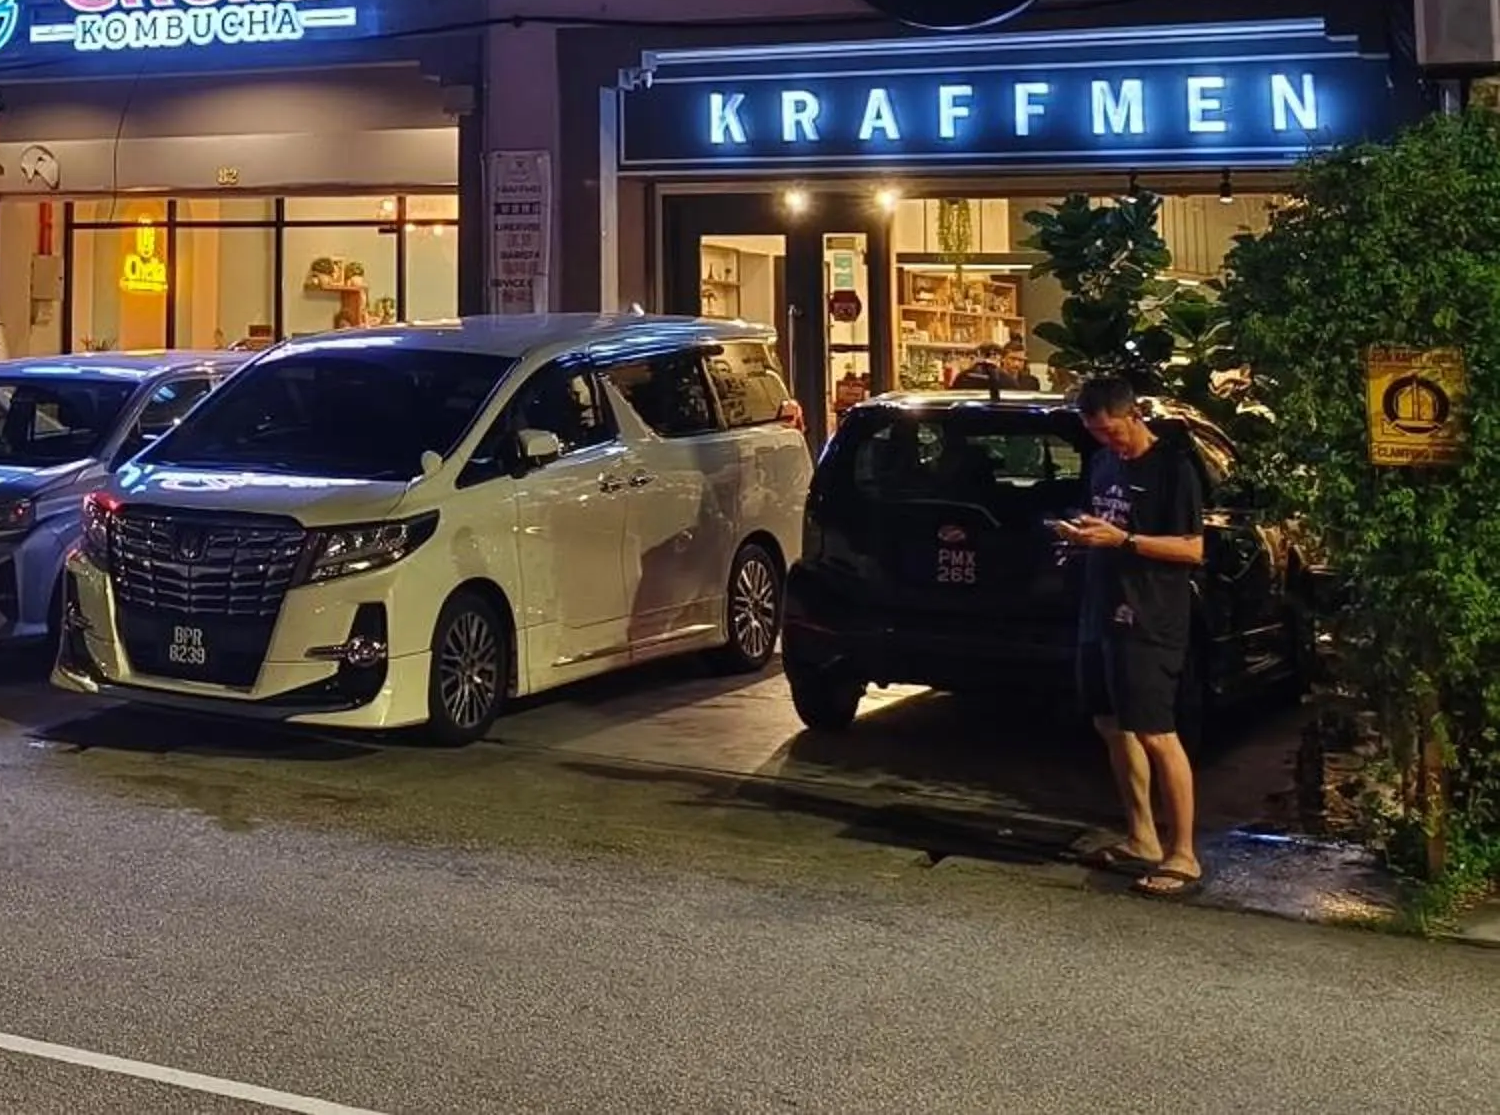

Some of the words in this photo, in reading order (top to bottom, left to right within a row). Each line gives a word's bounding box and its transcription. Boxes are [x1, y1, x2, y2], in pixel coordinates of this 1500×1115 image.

[74, 7, 304, 51] KOMBUCHA
[709, 72, 1319, 145] KRAFFMEN
[938, 549, 976, 566] PMX
